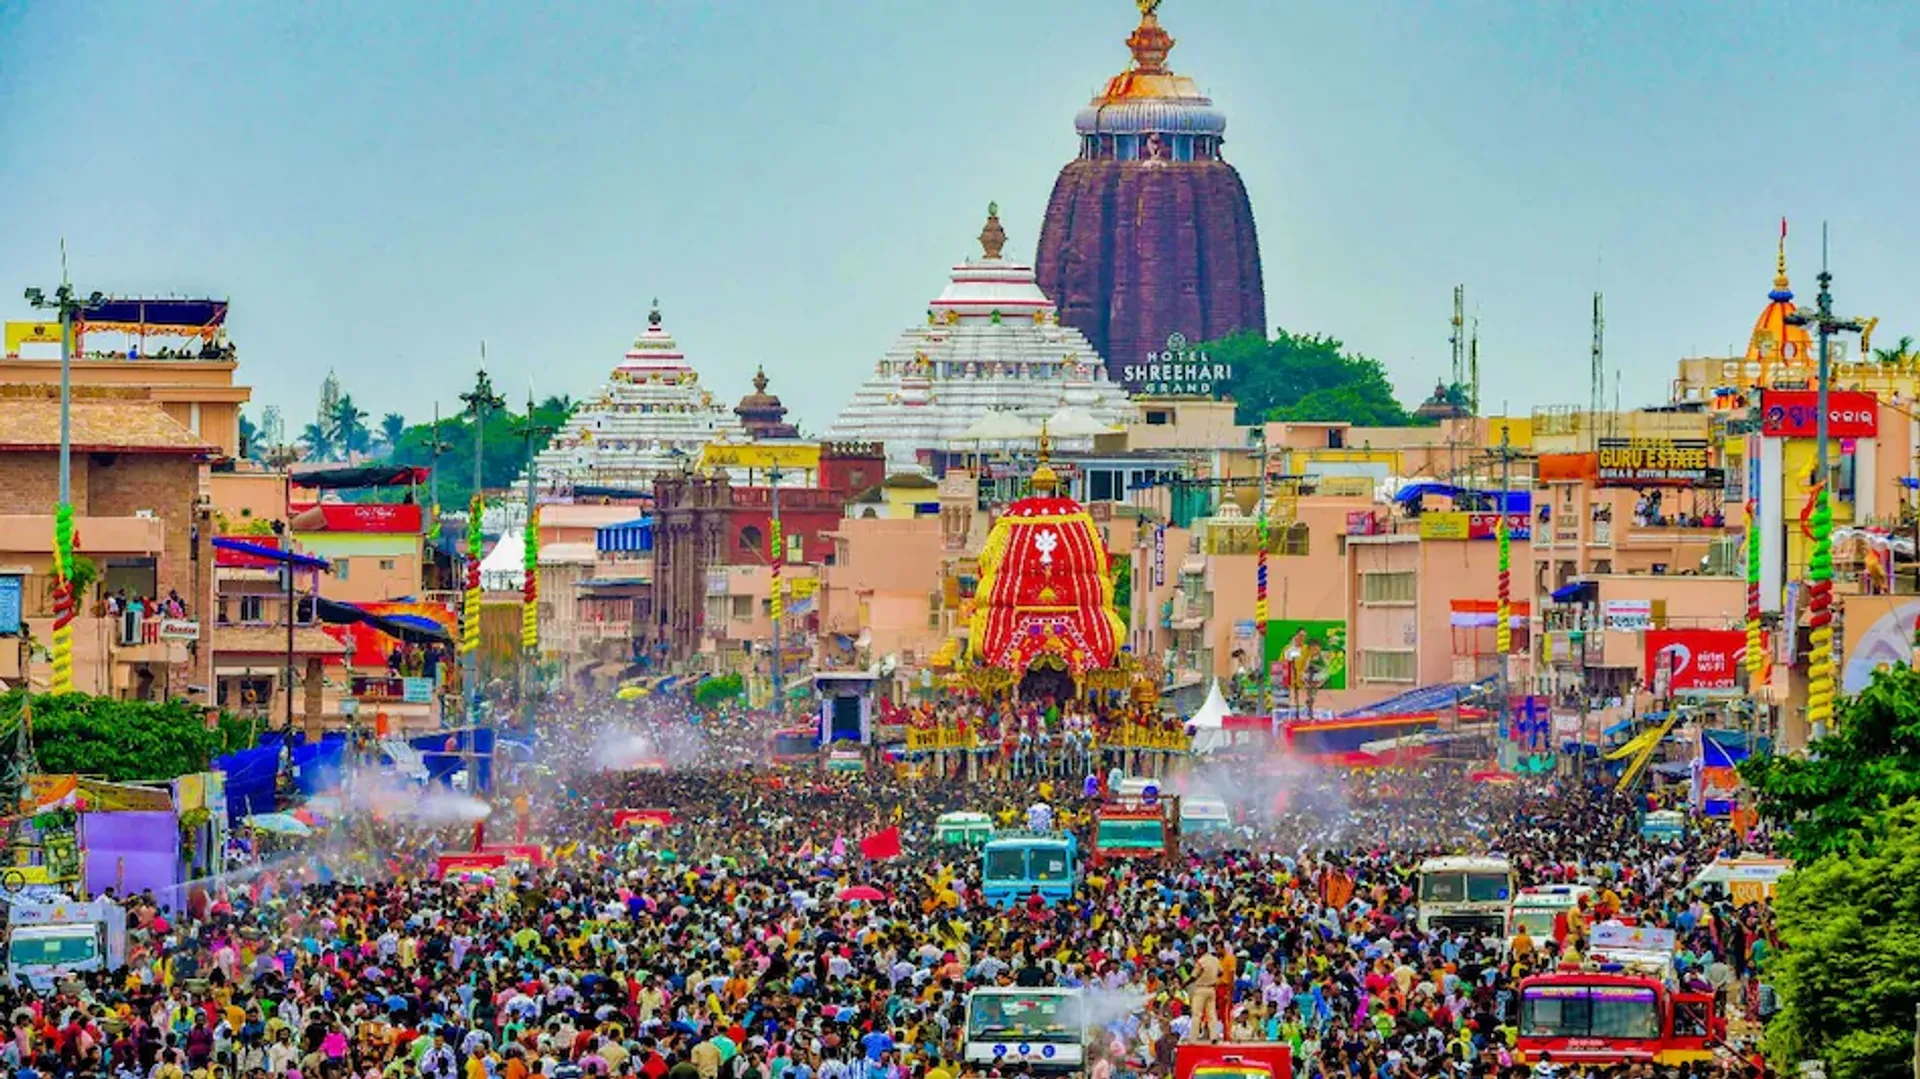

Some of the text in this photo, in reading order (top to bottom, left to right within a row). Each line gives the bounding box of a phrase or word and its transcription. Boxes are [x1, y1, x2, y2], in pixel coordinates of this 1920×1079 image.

[1147, 351, 1208, 361] HOTEL
[1124, 365, 1232, 381] SHREEHARI
[1145, 383, 1210, 392] GRAND
[1600, 449, 1706, 469] GURU ESTATE
[1697, 650, 1725, 662] airtel
